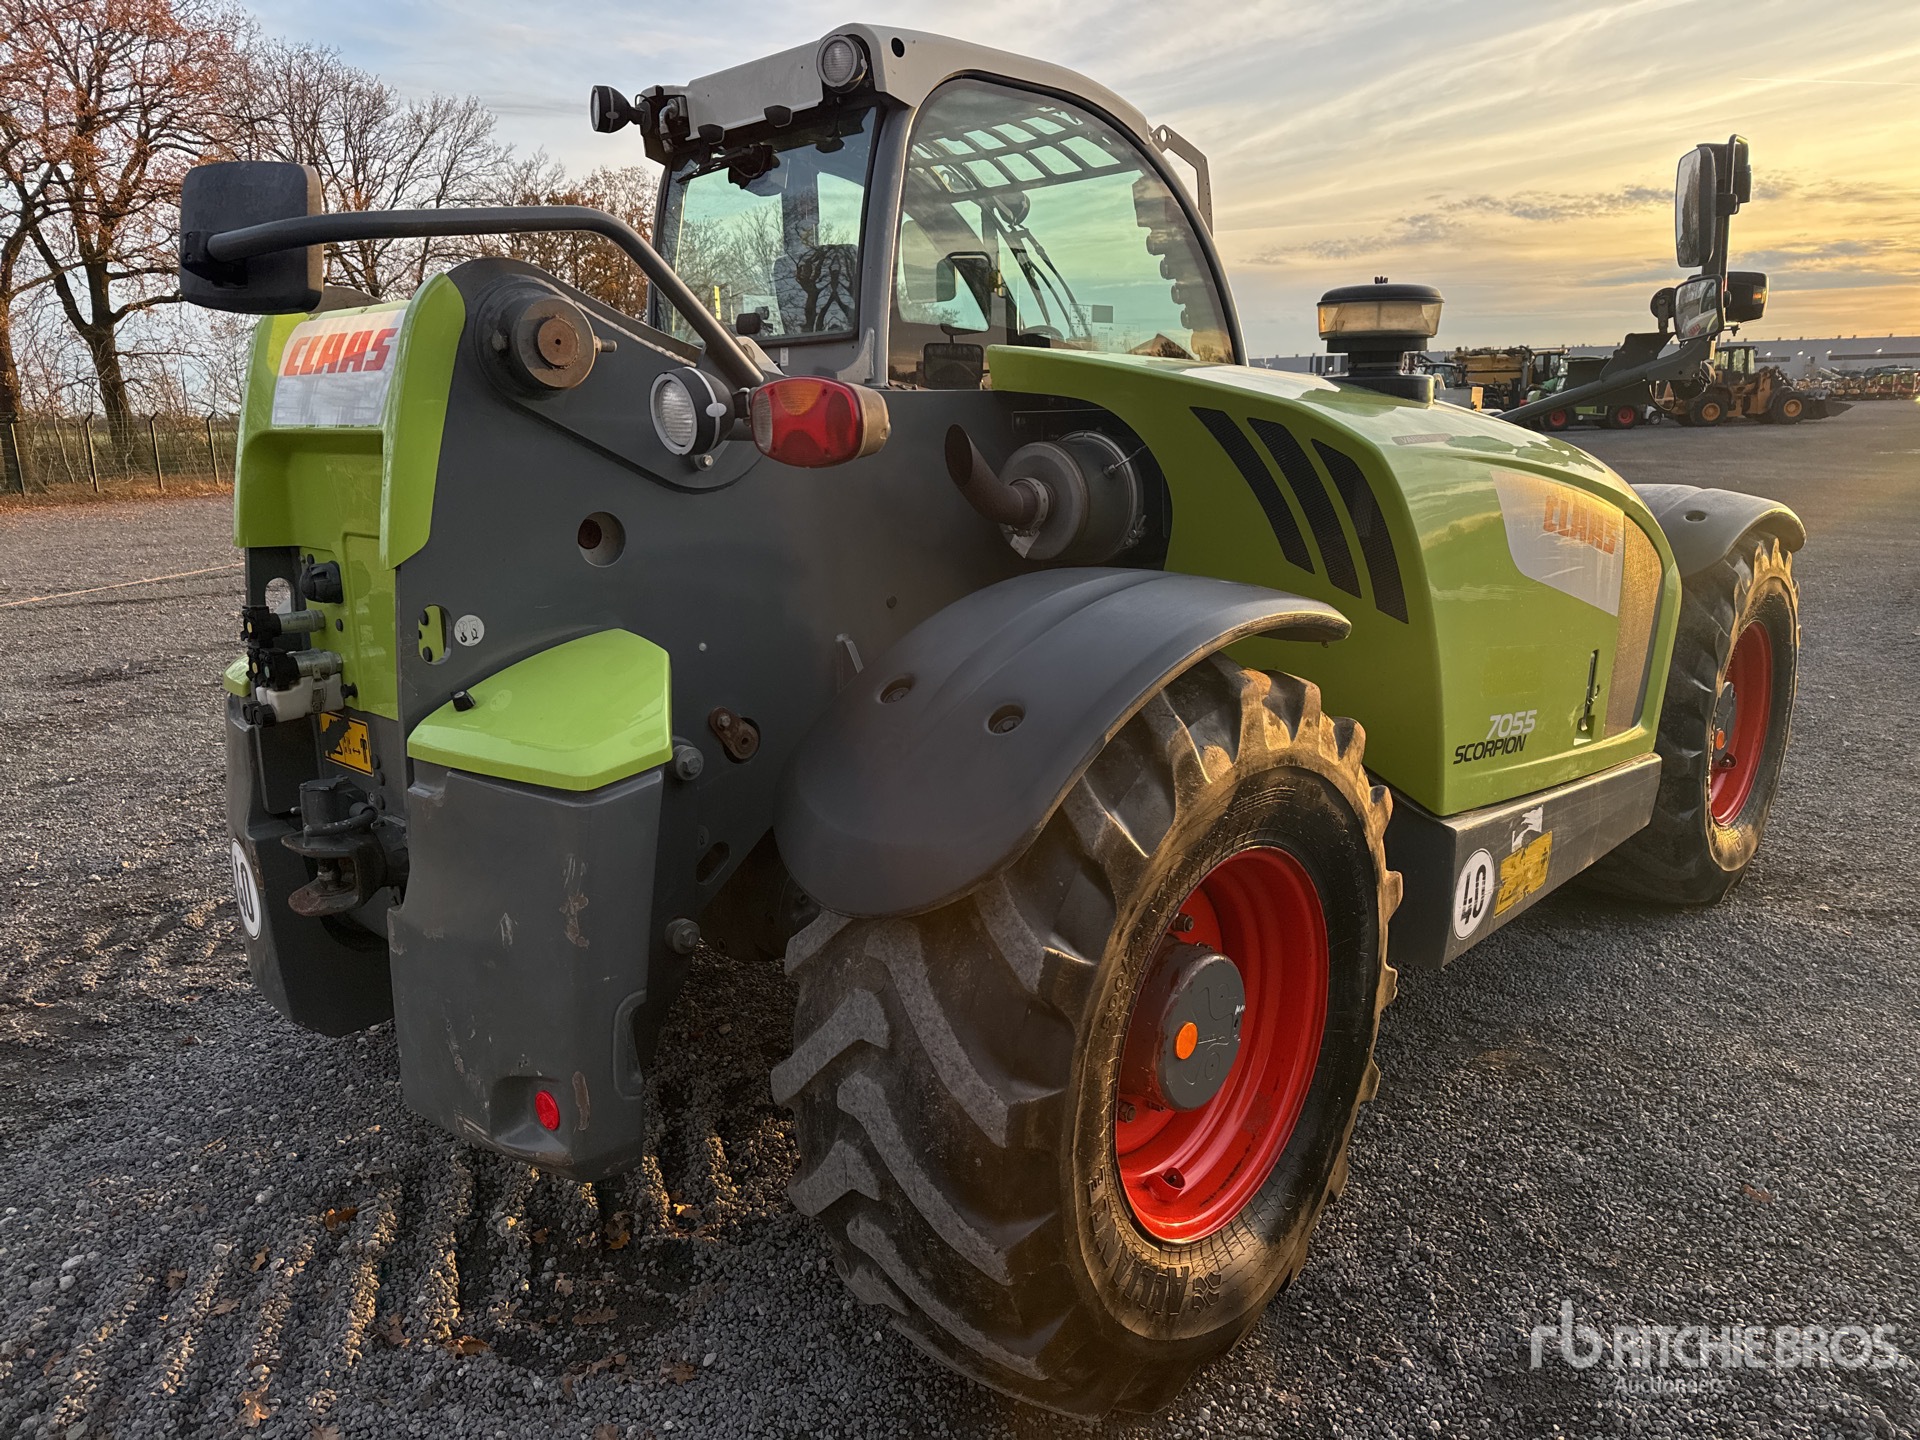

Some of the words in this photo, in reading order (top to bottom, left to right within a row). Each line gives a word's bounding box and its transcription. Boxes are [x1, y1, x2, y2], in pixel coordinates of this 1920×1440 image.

[283, 328, 399, 376] CLAAS
[1543, 495, 1617, 554] CLAAS
[1453, 734, 1527, 765] SCORPION
[1486, 709, 1537, 740] 7055
[233, 855, 255, 923] 40
[1460, 864, 1487, 925] 40
